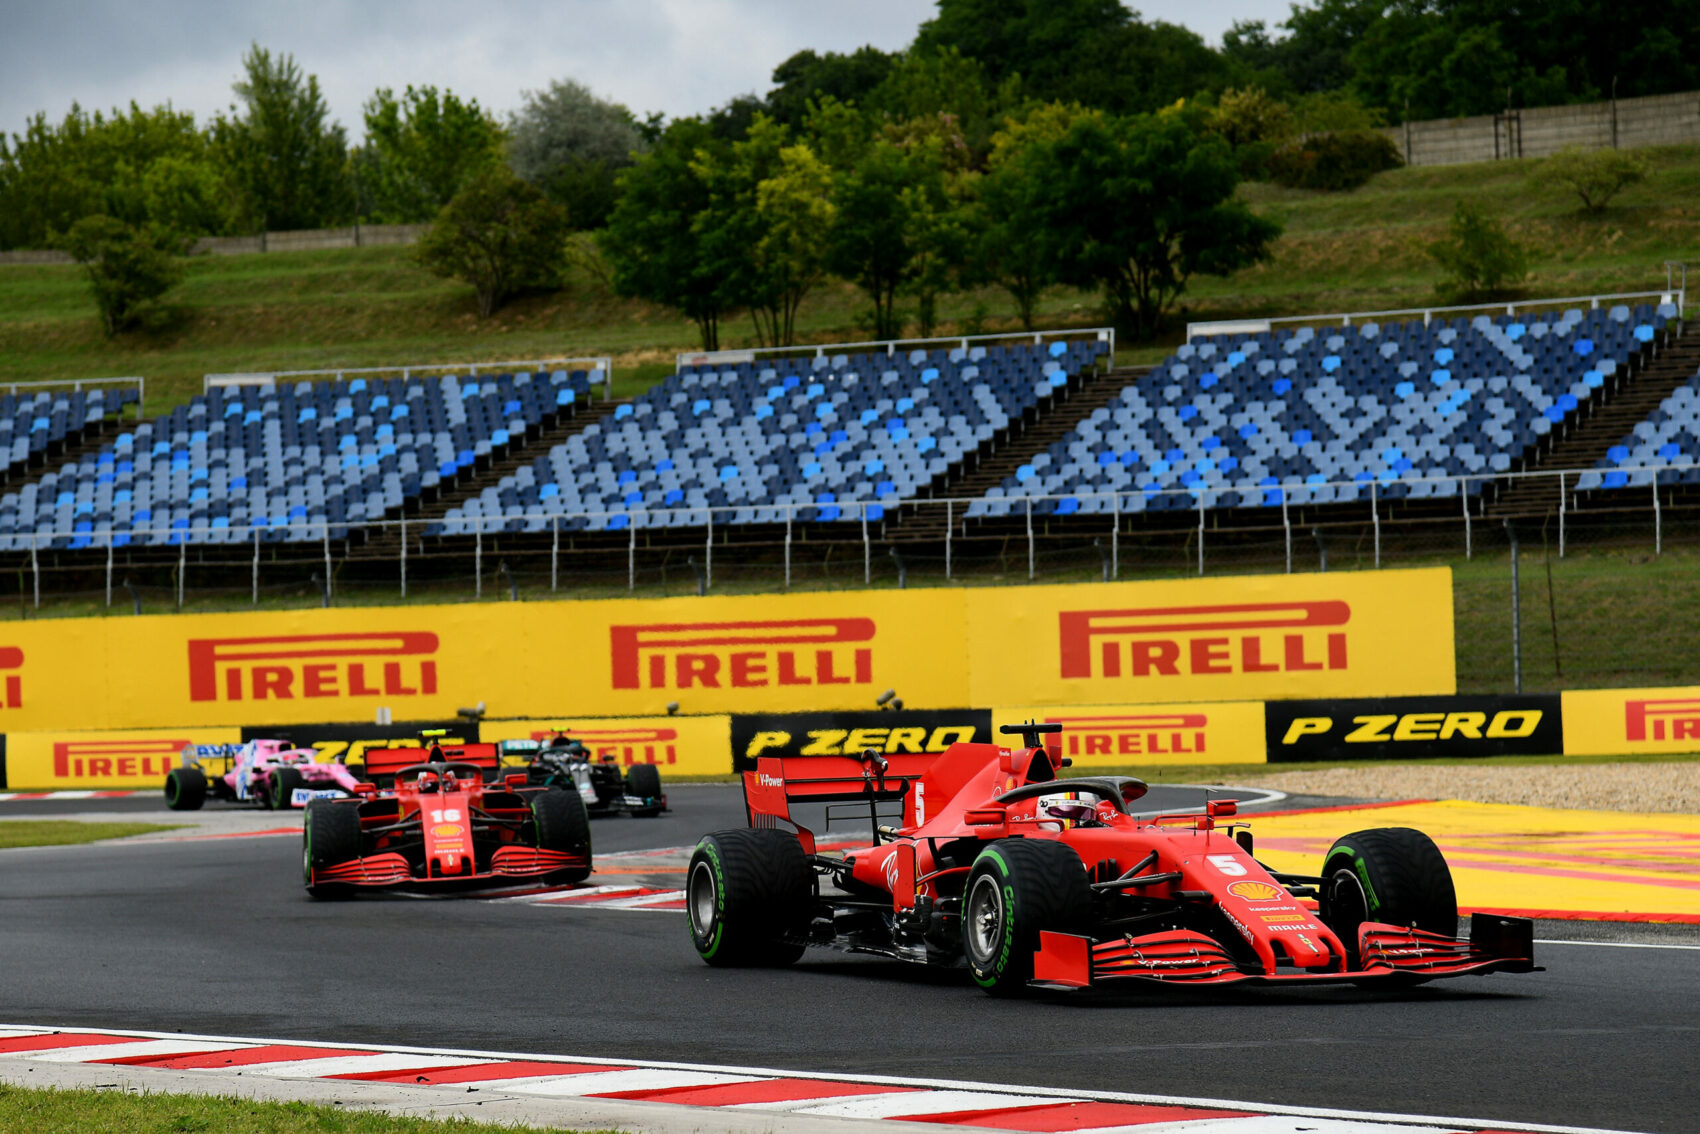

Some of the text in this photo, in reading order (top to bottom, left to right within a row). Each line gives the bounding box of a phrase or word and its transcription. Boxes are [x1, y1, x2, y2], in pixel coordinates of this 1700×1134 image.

[610, 618, 876, 690] PIRELLI
[1059, 600, 1351, 679] PIRELLI
[188, 631, 439, 702] PIRELLI
[745, 726, 976, 759] P ZERO
[1044, 714, 1208, 755] PIRELLI
[1282, 710, 1543, 744] P ZERO
[759, 773, 783, 787] V-Power
[430, 809, 461, 823] 16
[915, 781, 925, 829] 5
[1206, 855, 1248, 877] 5
[1268, 923, 1319, 932] MAHLE
